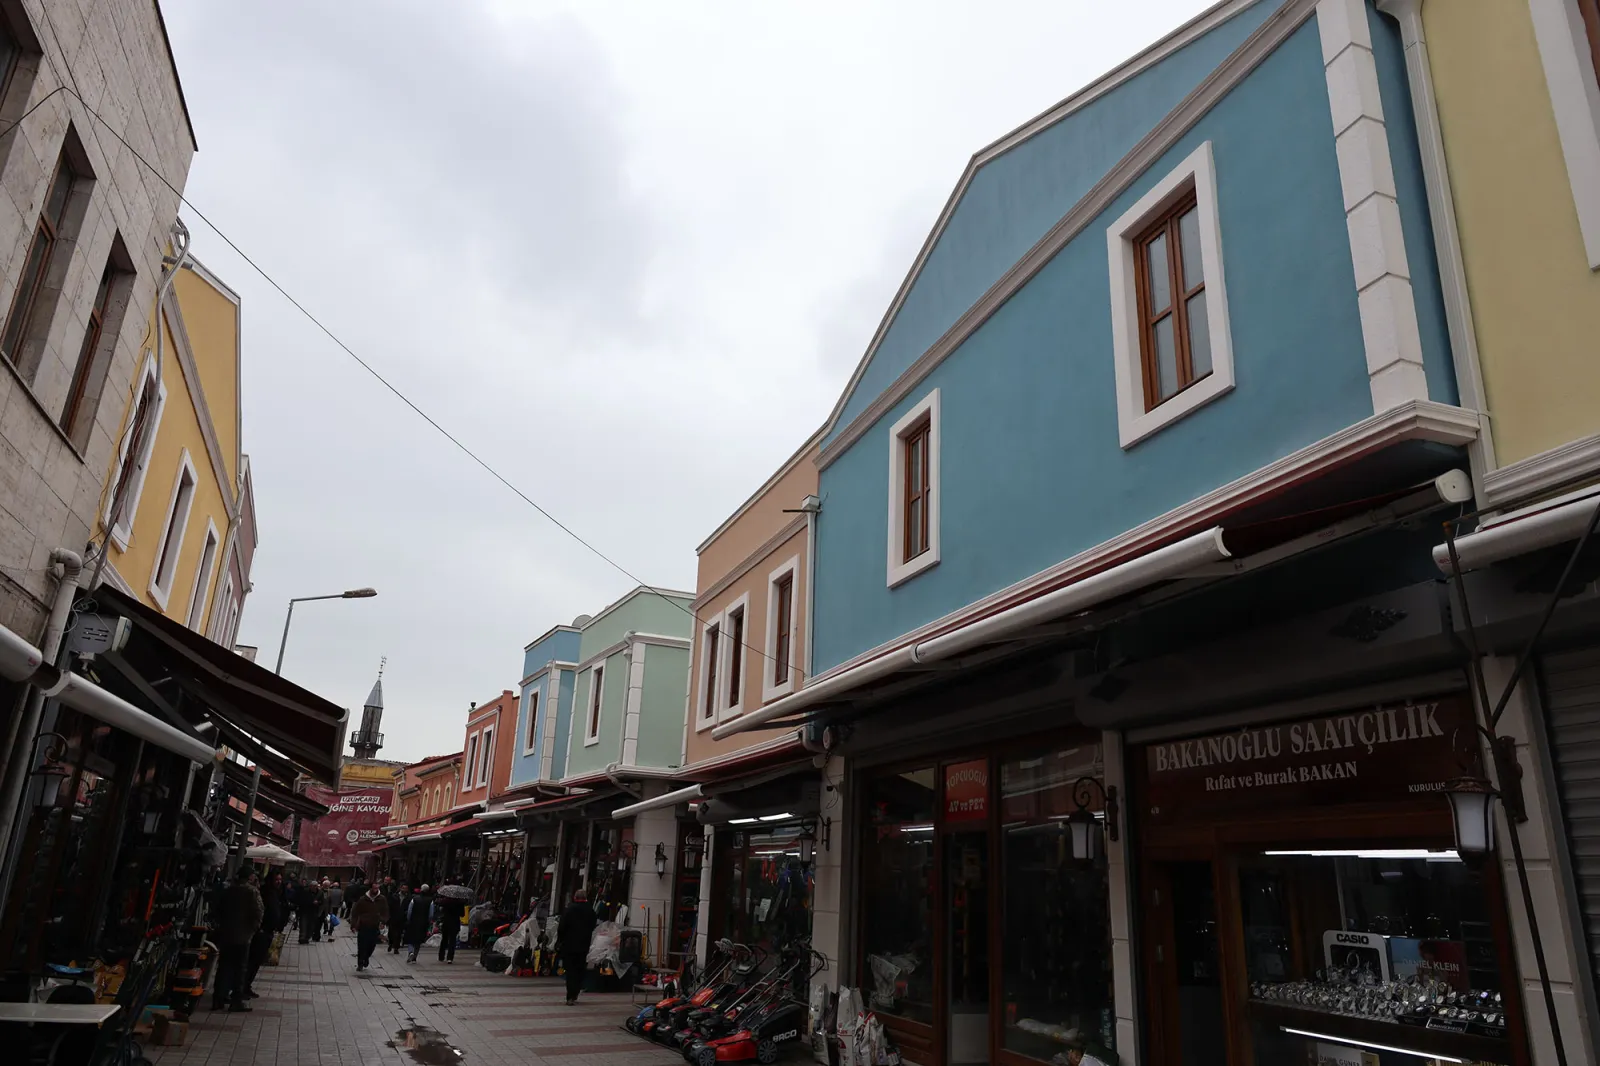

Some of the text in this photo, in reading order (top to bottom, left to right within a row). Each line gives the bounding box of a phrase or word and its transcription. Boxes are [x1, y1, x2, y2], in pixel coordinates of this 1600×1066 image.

[1155, 700, 1445, 772] BAKANOĞLU SAATÇİLİK
[1239, 774, 1253, 788] ve
[1254, 766, 1297, 787] Burak
[1299, 760, 1358, 782] BAKAN
[968, 797, 985, 812] PET
[1336, 933, 1369, 945] CASIO
[1433, 960, 1460, 972] KLEIN
